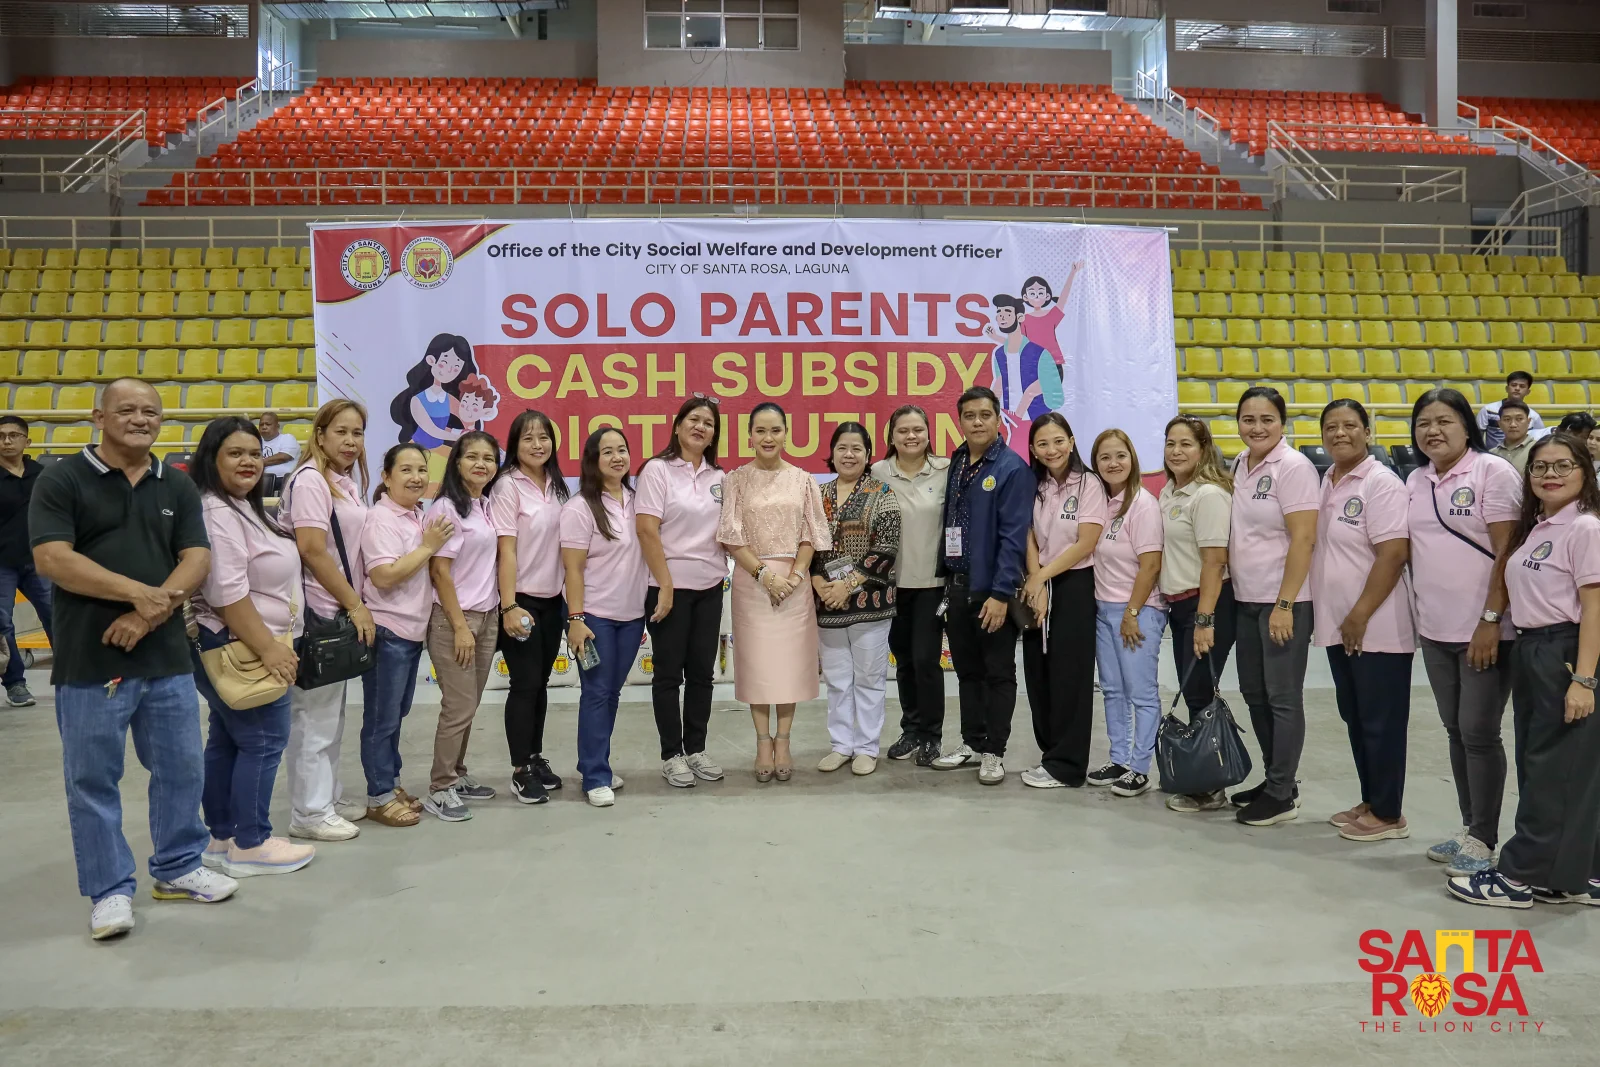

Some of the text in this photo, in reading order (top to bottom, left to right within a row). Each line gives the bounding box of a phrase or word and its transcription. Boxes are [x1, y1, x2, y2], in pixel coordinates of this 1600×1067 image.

[347, 245, 356, 253] OF
[357, 241, 381, 250] SANTA
[486, 242, 1003, 260] Office of the City Social Welfare and Development Officer
[645, 263, 850, 276] CITY OF SANTA ROSA, LAGUNA
[353, 280, 382, 289] LAGUNA
[502, 292, 990, 339] SOLO PARENTS
[506, 351, 988, 399] CASH SUBSIDY
[1449, 508, 1473, 517] B.O.D.
